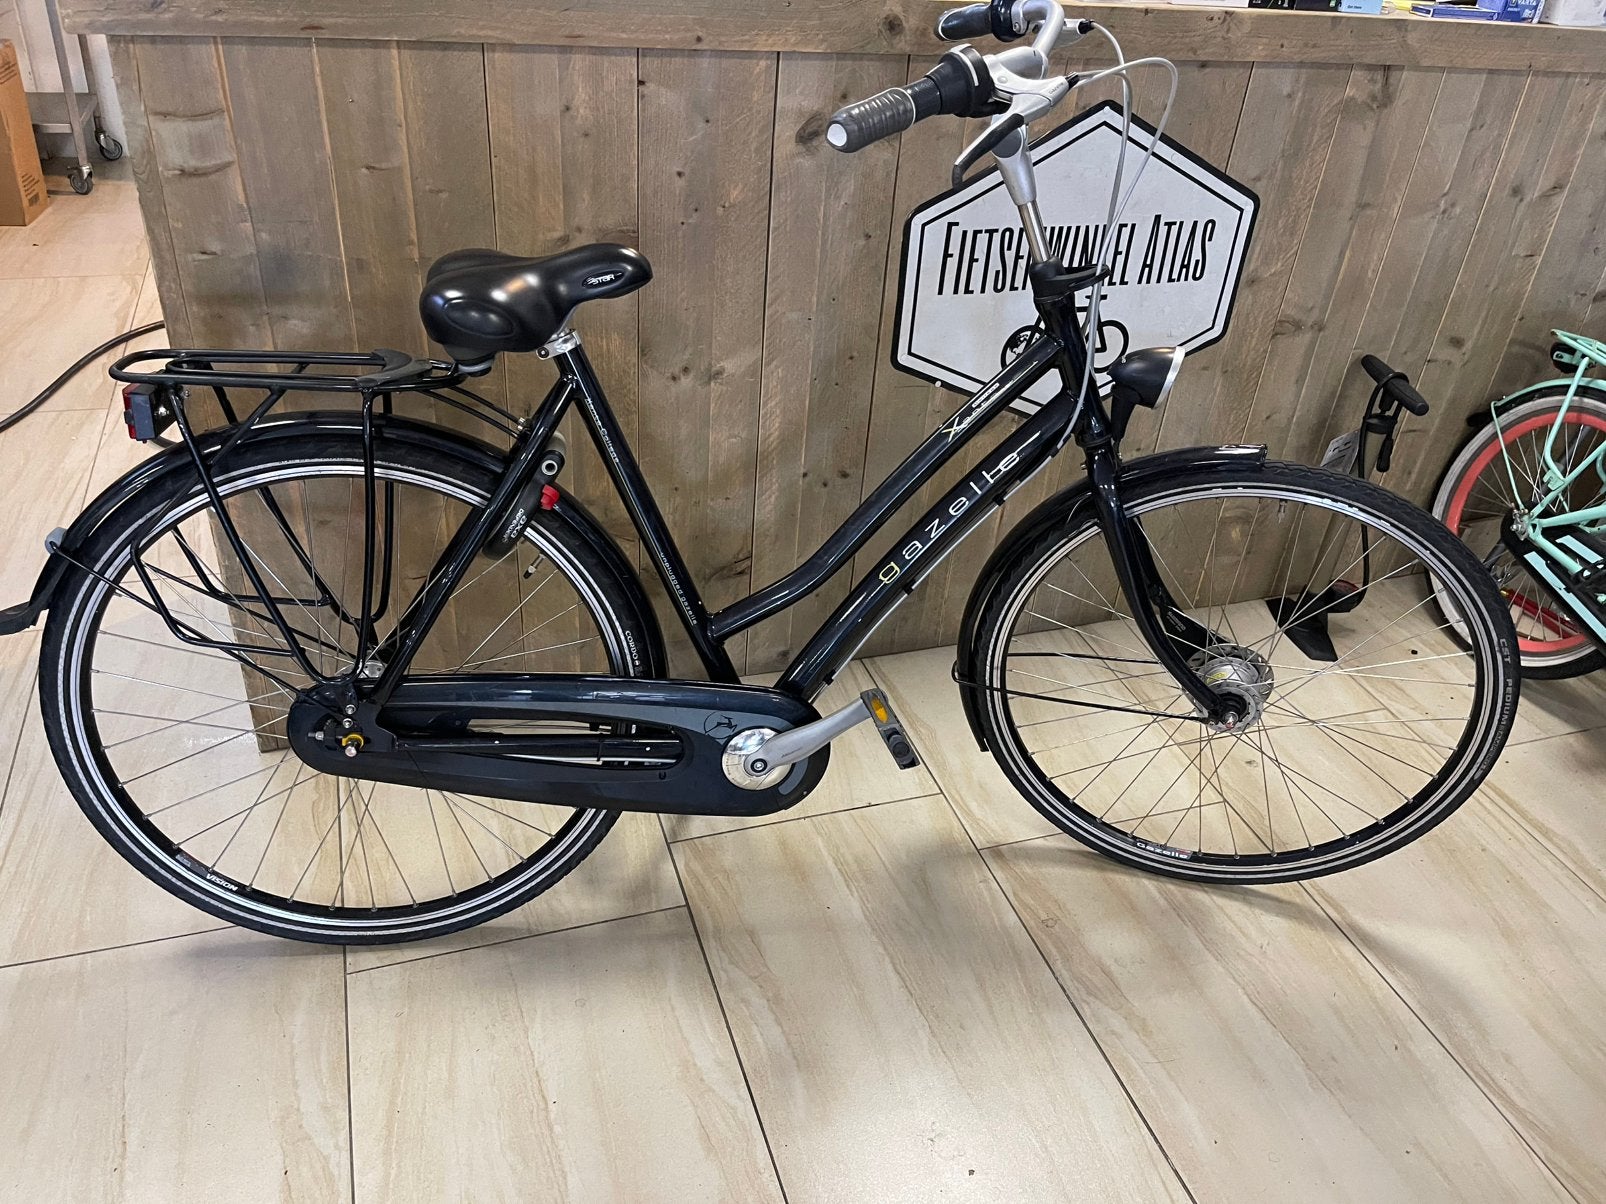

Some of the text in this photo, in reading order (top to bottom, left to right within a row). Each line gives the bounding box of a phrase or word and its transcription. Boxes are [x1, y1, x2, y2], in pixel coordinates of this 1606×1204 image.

[1137, 213, 1217, 285] ATLAS
[877, 435, 1036, 585] gazelle
[1500, 638, 1513, 725] CST PEDIUM
[206, 873, 239, 891] VISION
